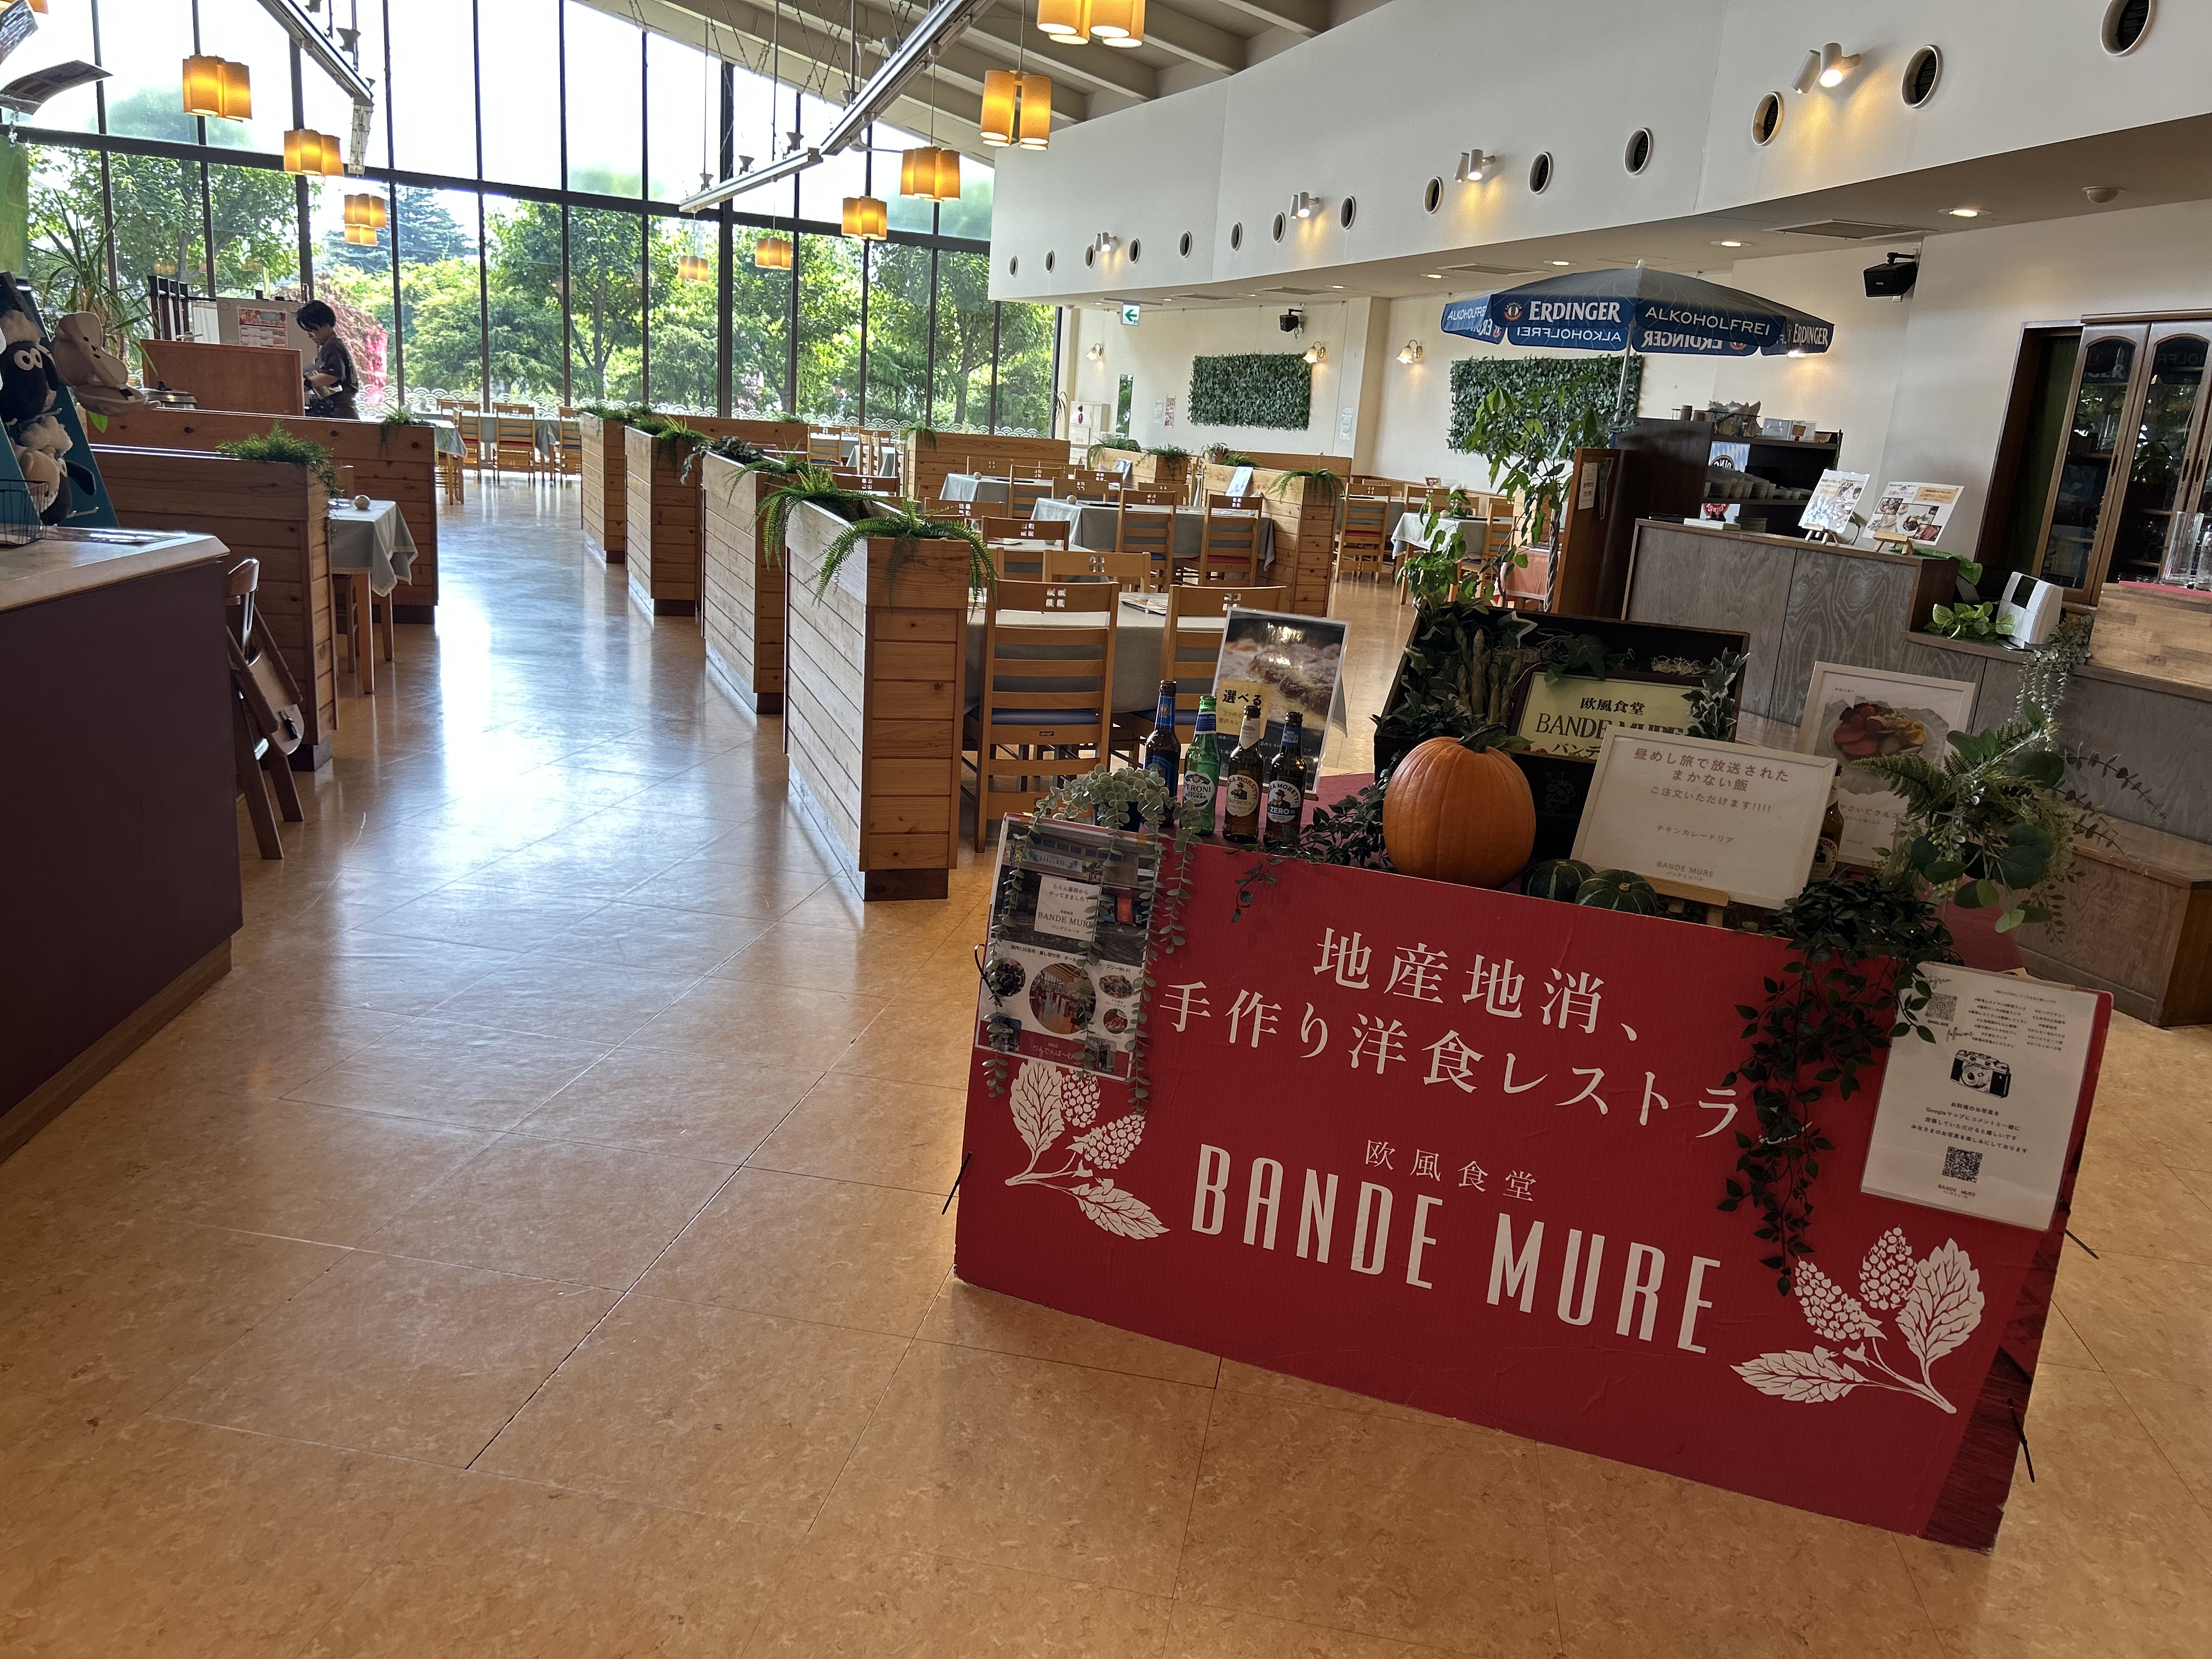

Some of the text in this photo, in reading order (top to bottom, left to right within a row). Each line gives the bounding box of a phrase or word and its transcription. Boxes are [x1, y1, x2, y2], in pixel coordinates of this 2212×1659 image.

[1447, 306, 1487, 320] ALKOHOLFRE
[1528, 301, 1621, 323] ERDINGER
[1645, 307, 1770, 336] ALKOHOLFREI
[1793, 324, 1828, 347] ERDINGER
[1222, 690, 1262, 706] 選べる
[1580, 697, 1645, 715] 欧風食堂
[1535, 713, 1612, 740] BANDE
[1633, 748, 1788, 782] 昼めし旅で放送された
[1184, 781, 1211, 793] PERONI
[1672, 769, 1749, 792] まかない飯
[1278, 783, 1299, 804] MORETTI
[1270, 806, 1290, 815] ZERO
[1657, 825, 1734, 843] チキンカレードリア
[1656, 861, 1714, 877] BANDE MURE
[1038, 911, 1066, 923] BANDE
[1313, 927, 1638, 1041] 地産地消、
[1951, 1102, 1999, 1116] お料理のお写真を
[1911, 1124, 2028, 1153] みなさまのお写真を楽しみにしております
[1925, 1117, 2017, 1141] 投稿していただけると嬉しいです
[1365, 1139, 1537, 1202] 欧風食堂
[1938, 1184, 1957, 1193] BANDE
[1192, 1144, 1721, 1354] BANDE MURE
